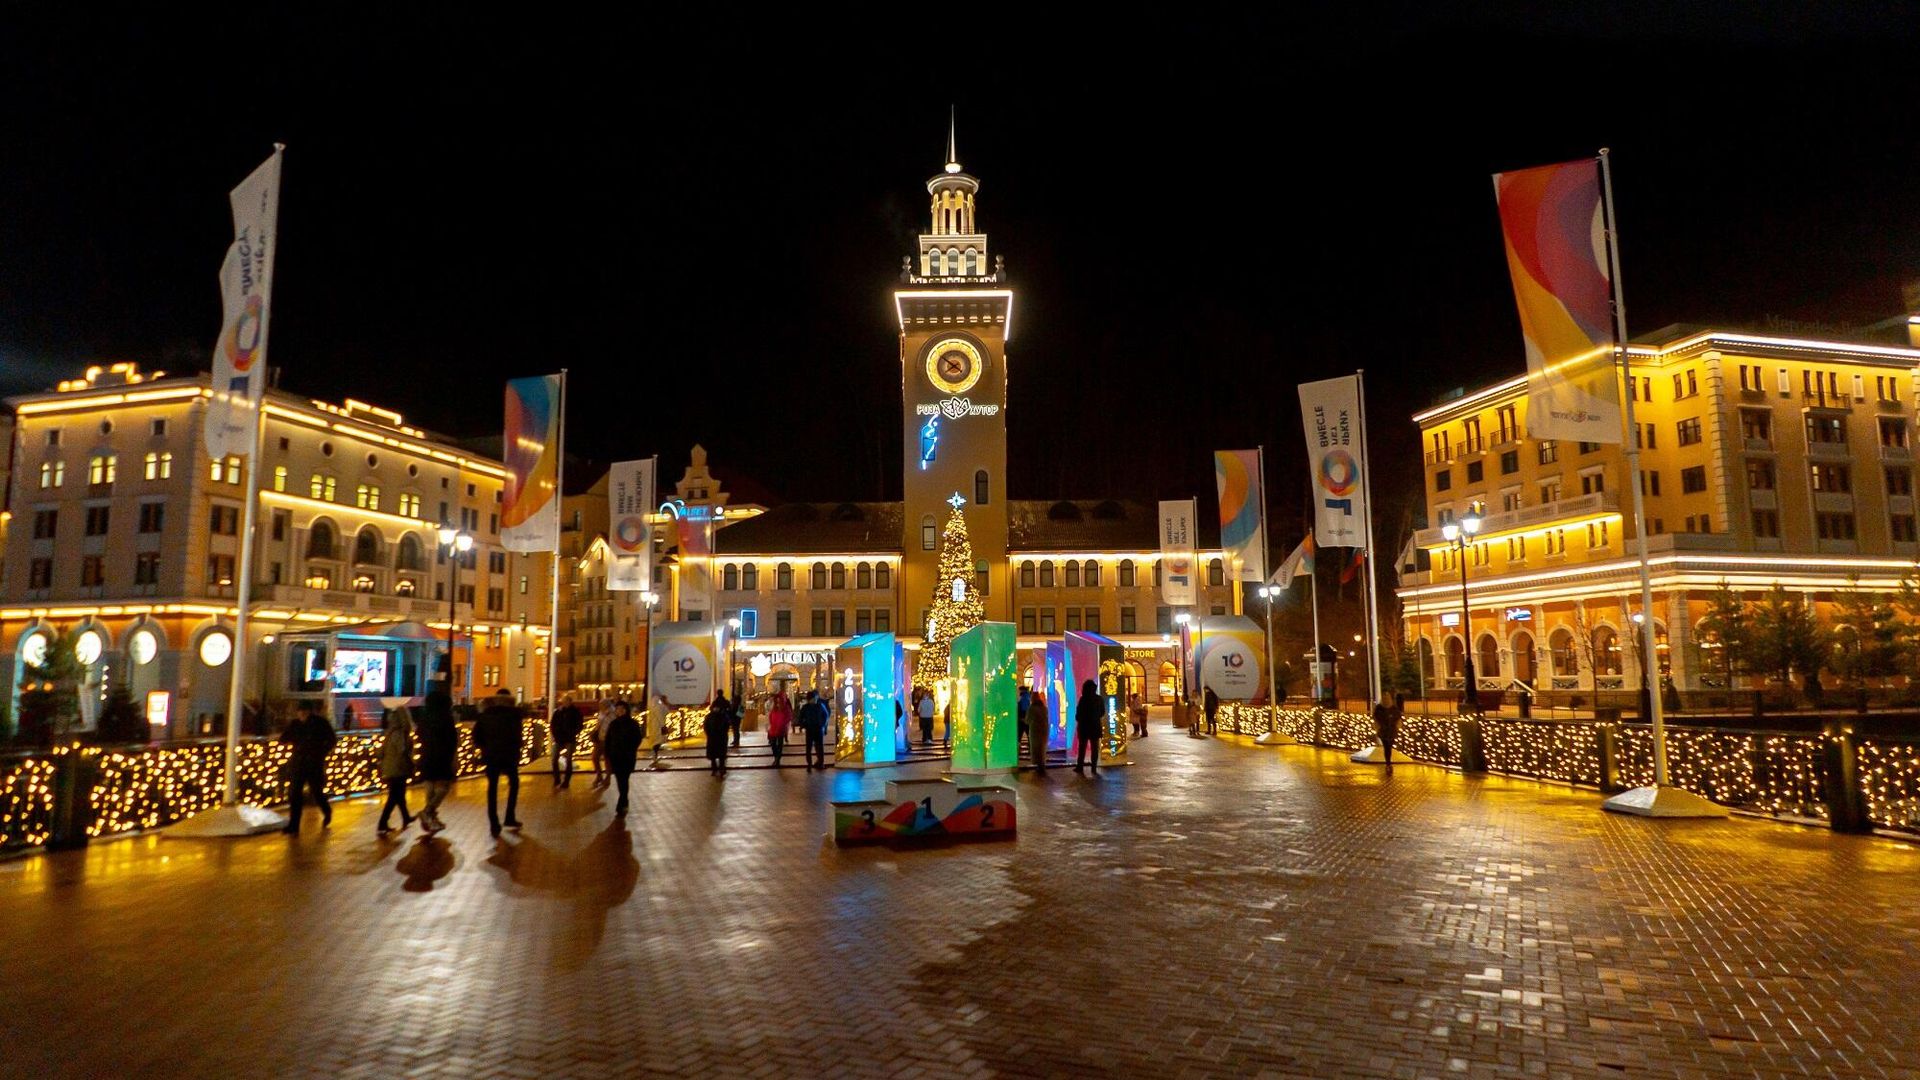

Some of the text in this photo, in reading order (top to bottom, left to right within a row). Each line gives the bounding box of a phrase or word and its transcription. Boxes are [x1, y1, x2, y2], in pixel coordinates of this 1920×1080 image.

[916, 403, 999, 416] РОЗА ХУТОР
[1130, 650, 1156, 658] STORE
[1222, 653, 1243, 667] 10
[673, 657, 695, 672] 10
[920, 796, 938, 820] 1
[861, 809, 876, 834] 3
[979, 805, 995, 828] 2
